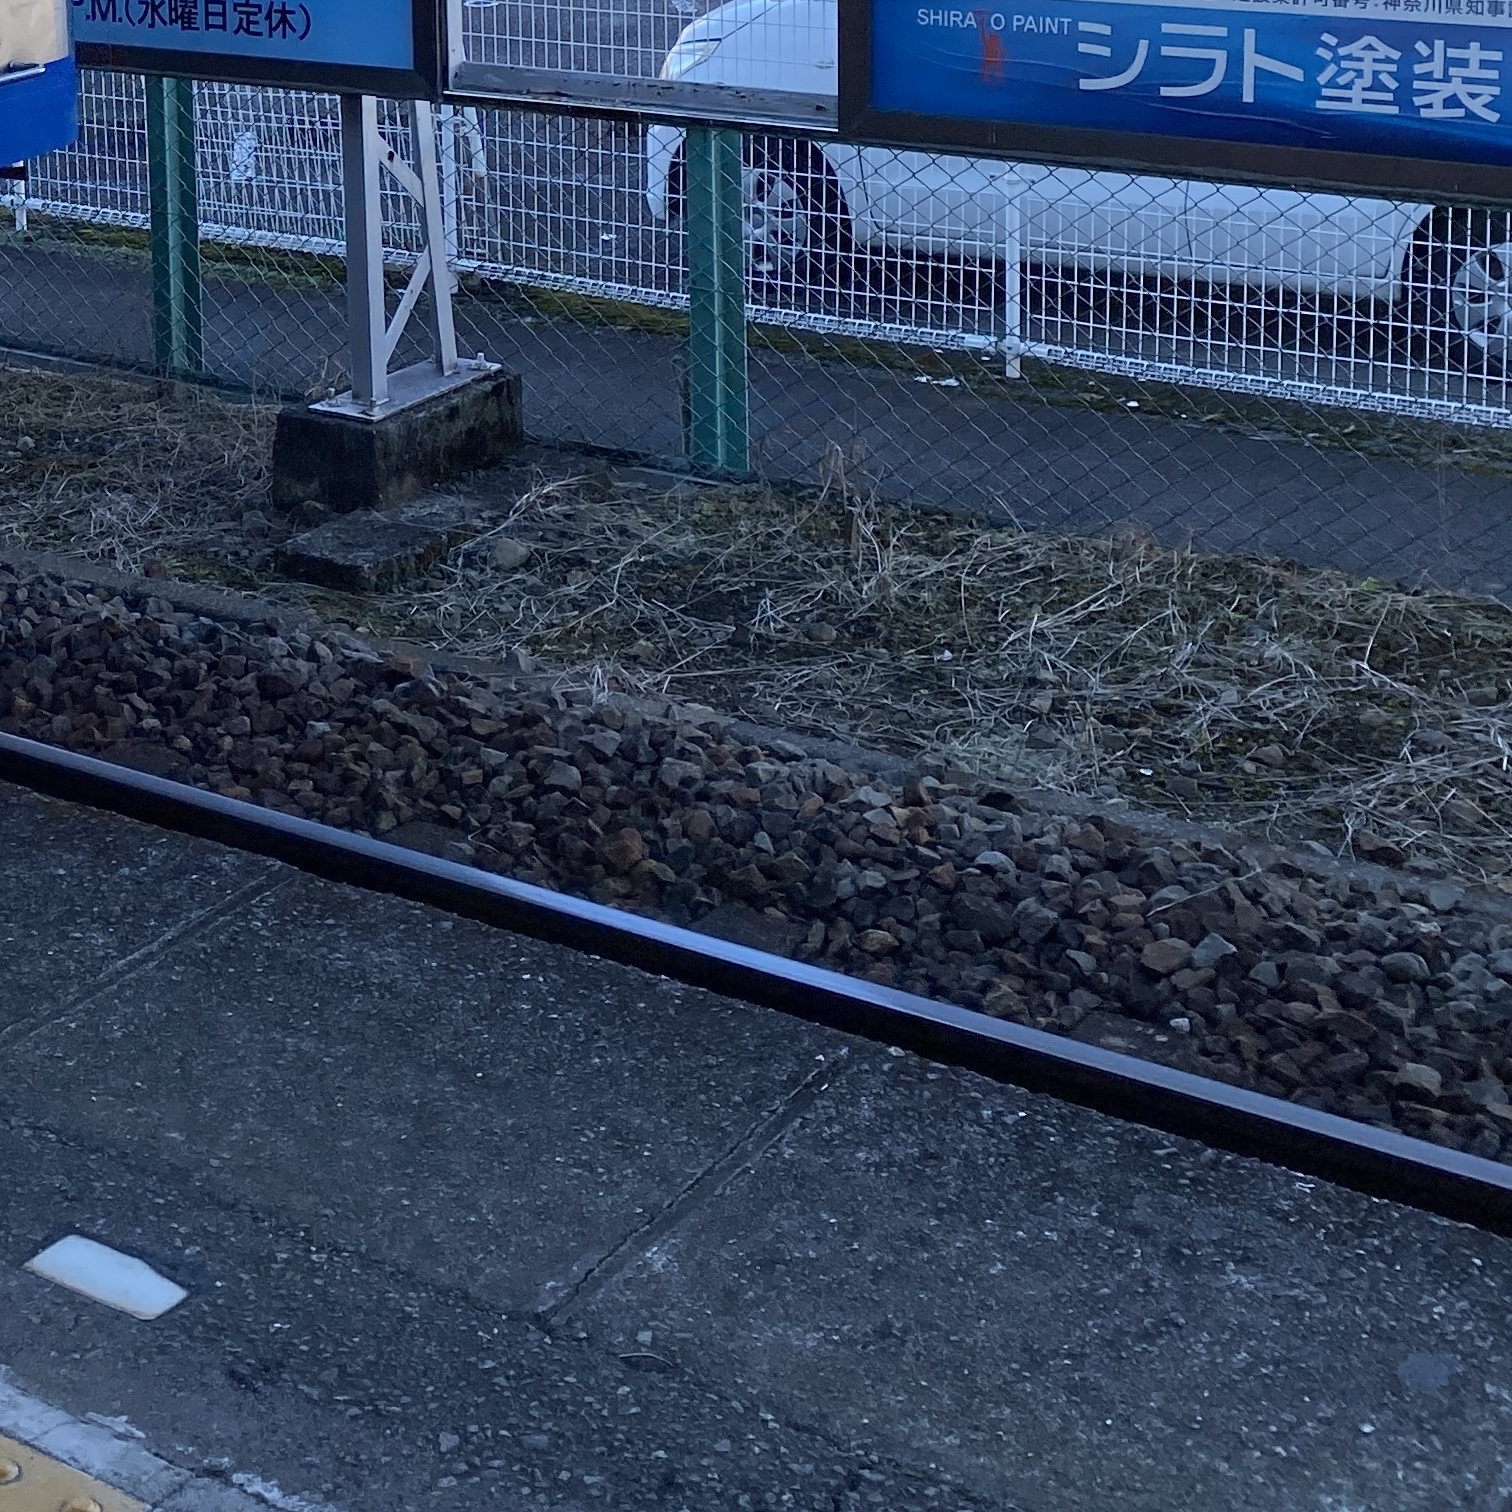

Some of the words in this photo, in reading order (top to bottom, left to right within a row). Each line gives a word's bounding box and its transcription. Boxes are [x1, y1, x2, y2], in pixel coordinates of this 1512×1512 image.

[1012, 13, 1072, 36] PAINT
[1078, 20, 1502, 125] シラト塗装
